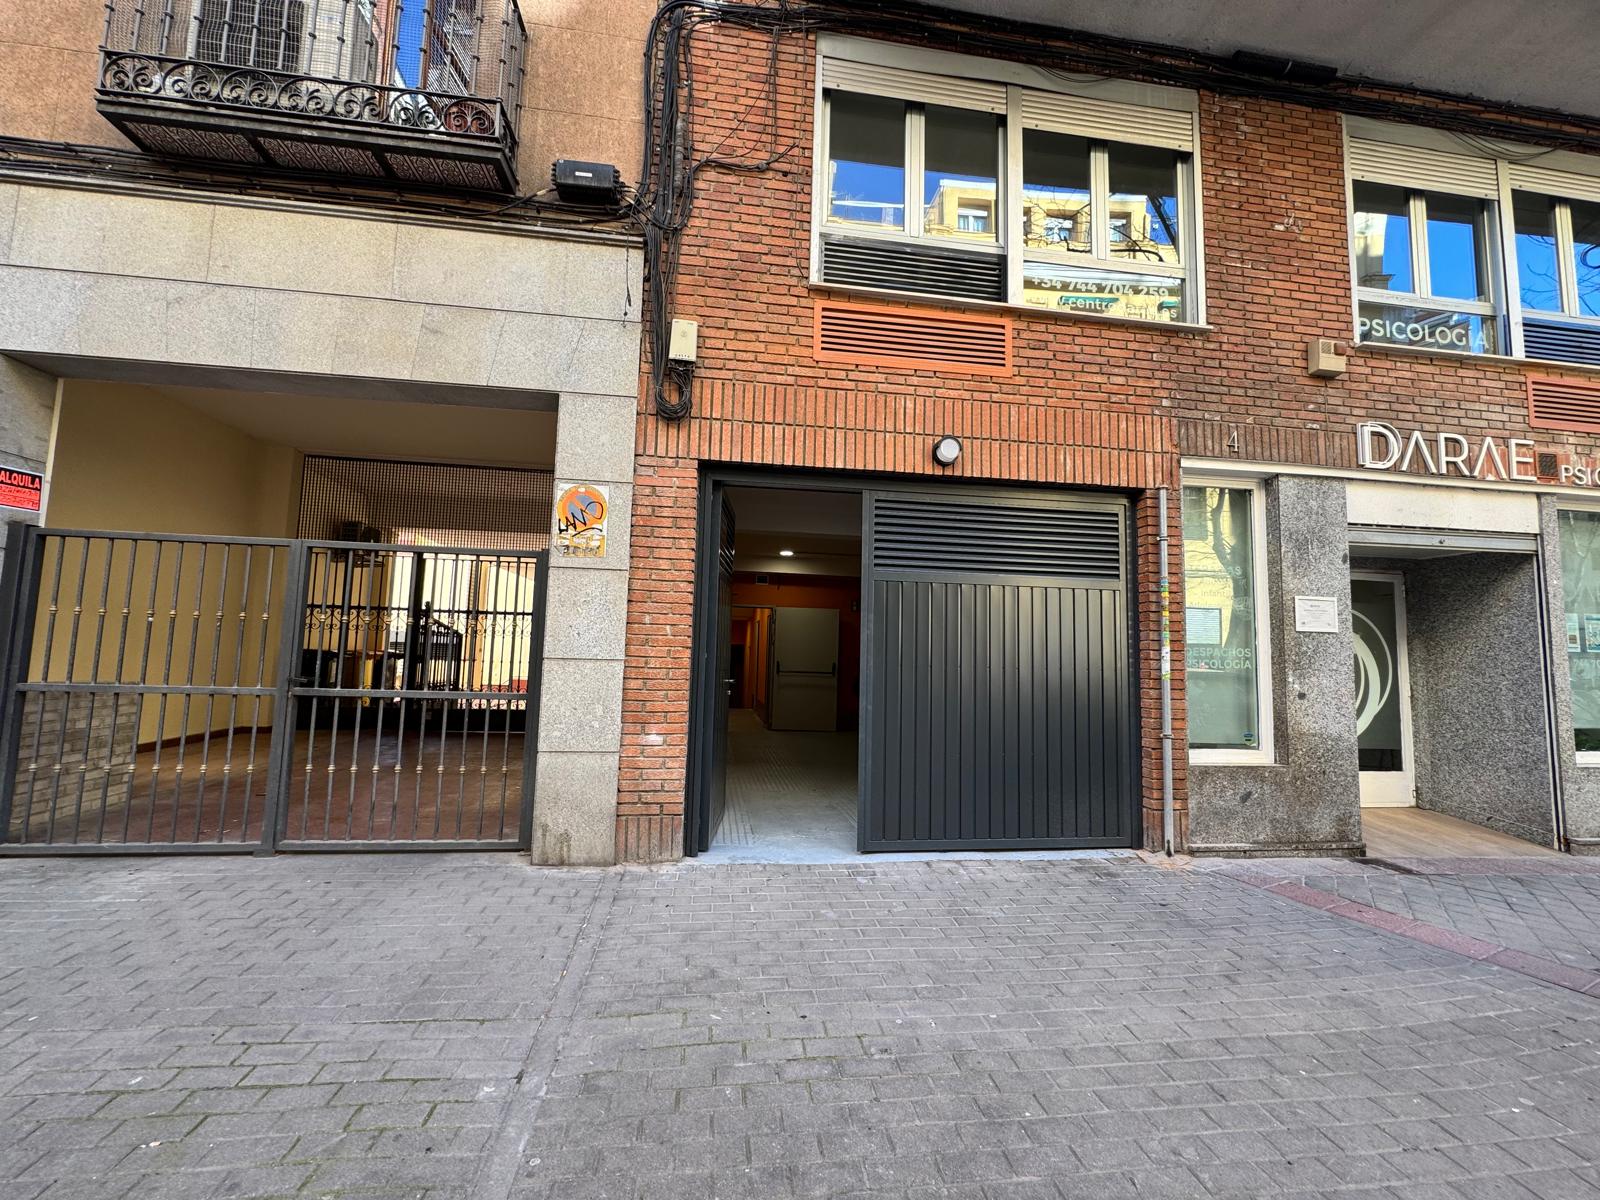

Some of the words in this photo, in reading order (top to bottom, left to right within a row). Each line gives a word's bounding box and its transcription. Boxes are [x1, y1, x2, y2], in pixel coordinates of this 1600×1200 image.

[1067, 280, 1098, 293] 744
[1103, 282, 1135, 296] 704
[1138, 285, 1169, 298] 259
[1228, 430, 1240, 452] 4
[1356, 421, 1538, 482] DARAE
[0, 470, 40, 489] ALQUILA
[1186, 647, 1252, 658] DESPACHOS
[1186, 657, 1252, 669] PSICOLOGÍA
